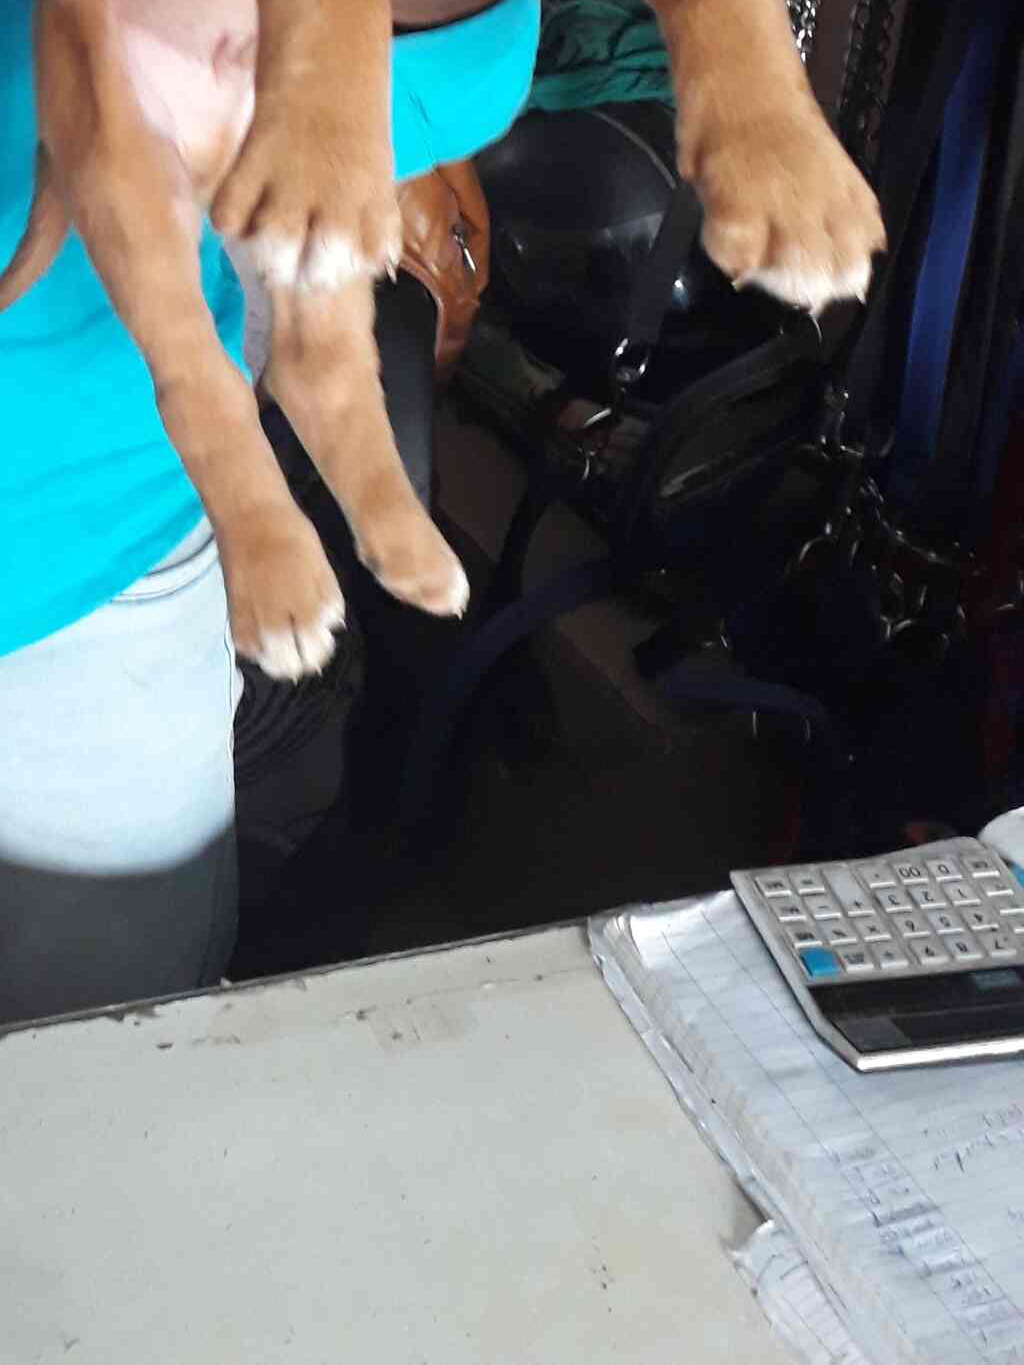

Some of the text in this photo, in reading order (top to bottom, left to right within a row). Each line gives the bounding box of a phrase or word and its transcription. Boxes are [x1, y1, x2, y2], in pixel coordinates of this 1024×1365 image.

[899, 866, 921, 878] 00
[938, 864, 950, 875] 0
[888, 894, 901, 906] 3
[903, 920, 916, 932] 6
